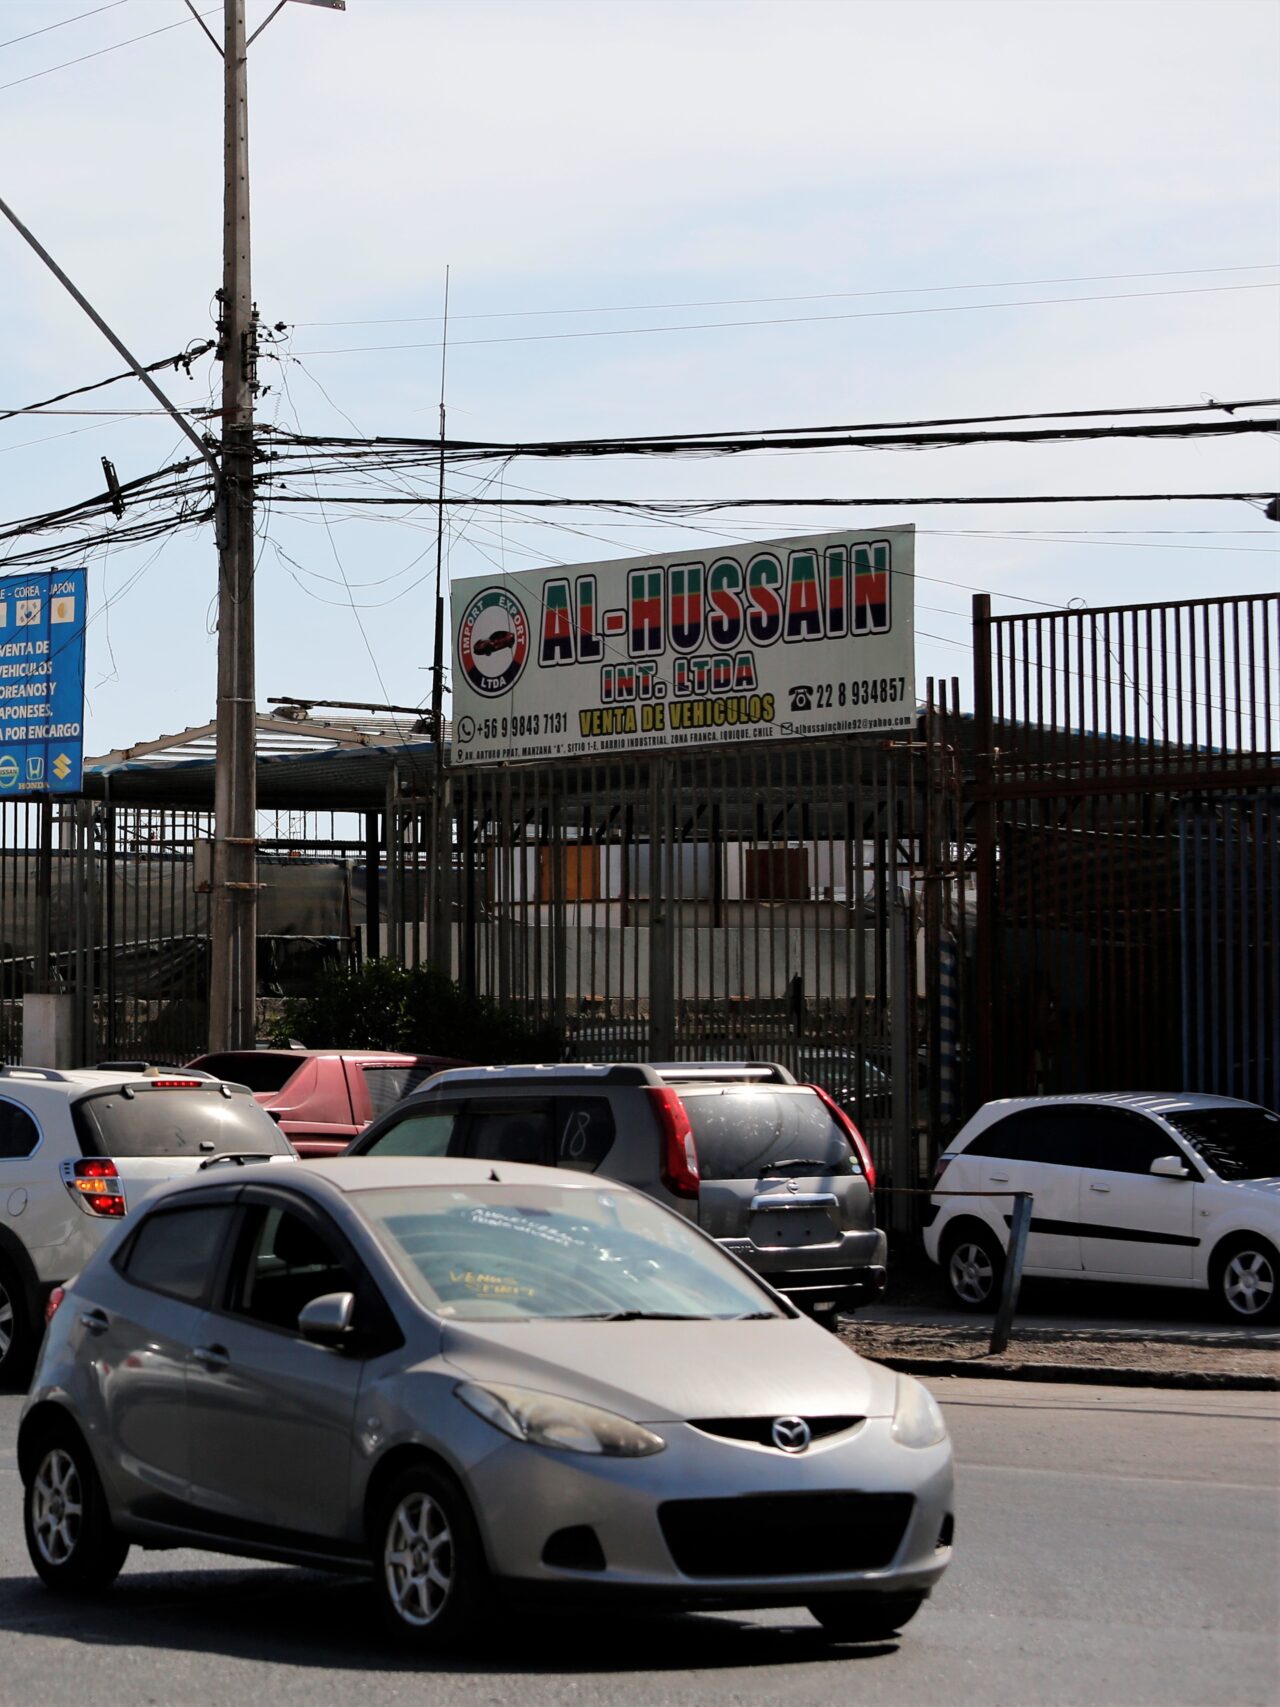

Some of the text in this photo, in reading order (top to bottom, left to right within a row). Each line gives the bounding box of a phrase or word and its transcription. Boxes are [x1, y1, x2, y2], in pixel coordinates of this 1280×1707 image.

[14, 585, 40, 599] COREA
[539, 539, 891, 667] AL-HUSSAIN
[463, 600, 484, 654] IMPORT
[498, 596, 525, 645] EXPORT
[36, 640, 50, 654] DE
[49, 682, 57, 695] Y
[480, 676, 507, 689] LTDA
[601, 651, 758, 703] INT. LTDA
[816, 677, 905, 708] 22 8 934857
[477, 712, 568, 739] +56 9 9843 7131
[579, 693, 776, 737] VENTA DE VEHICULOS
[5, 727, 26, 741] POR
[28, 723, 80, 739] ENCARGO
[560, 1111, 590, 1156] 18
